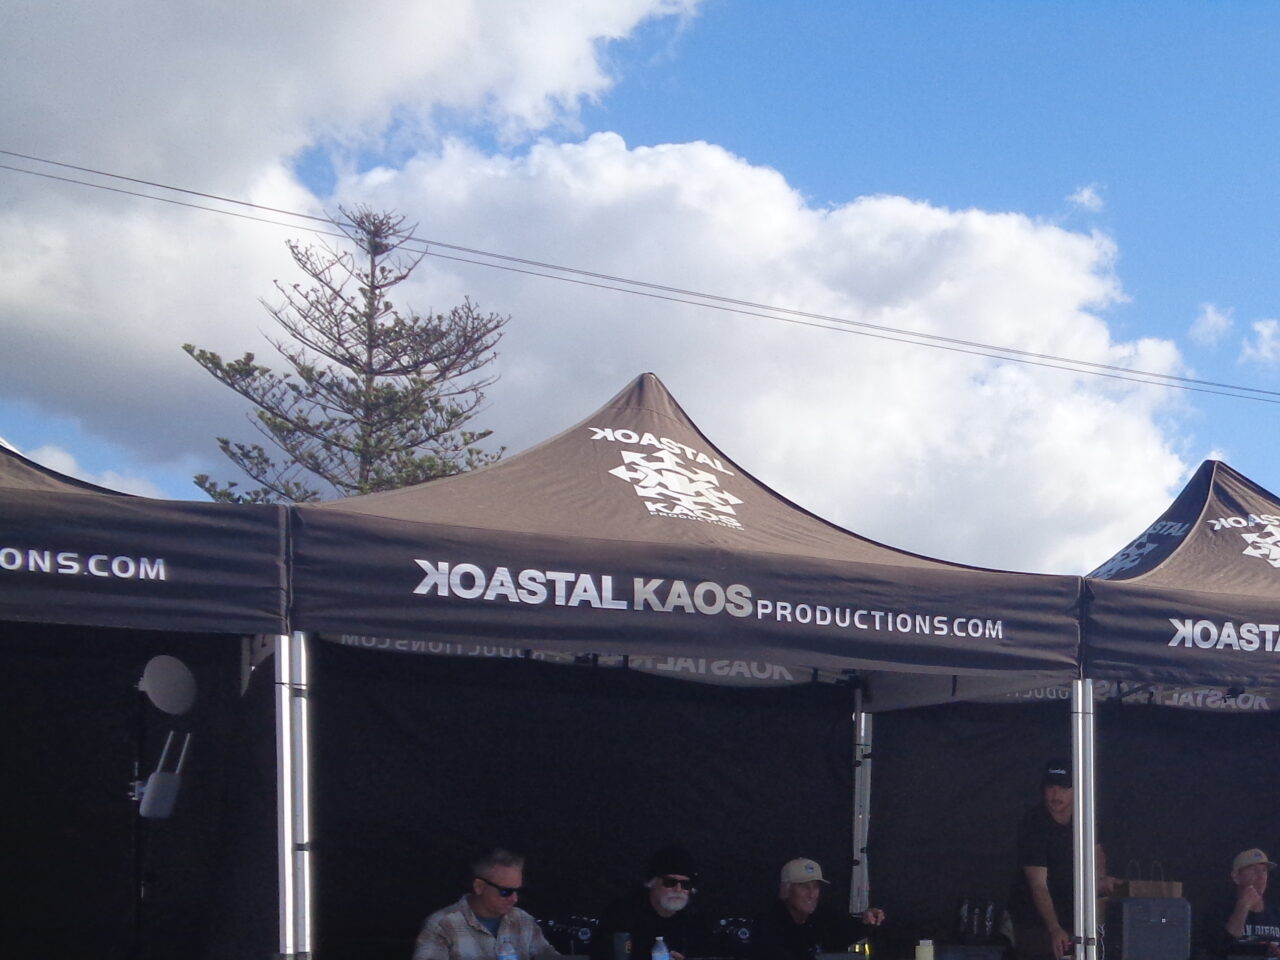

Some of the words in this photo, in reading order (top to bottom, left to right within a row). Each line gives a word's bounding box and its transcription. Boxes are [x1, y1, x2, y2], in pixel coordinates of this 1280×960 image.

[588, 427, 735, 476] KOASTAL
[643, 500, 743, 527] KAOS
[0, 547, 166, 581] ONS.COM
[412, 558, 628, 610] KOASTAL
[633, 577, 755, 618] KAOS
[757, 600, 1003, 639] PRODUCTIONS.COM
